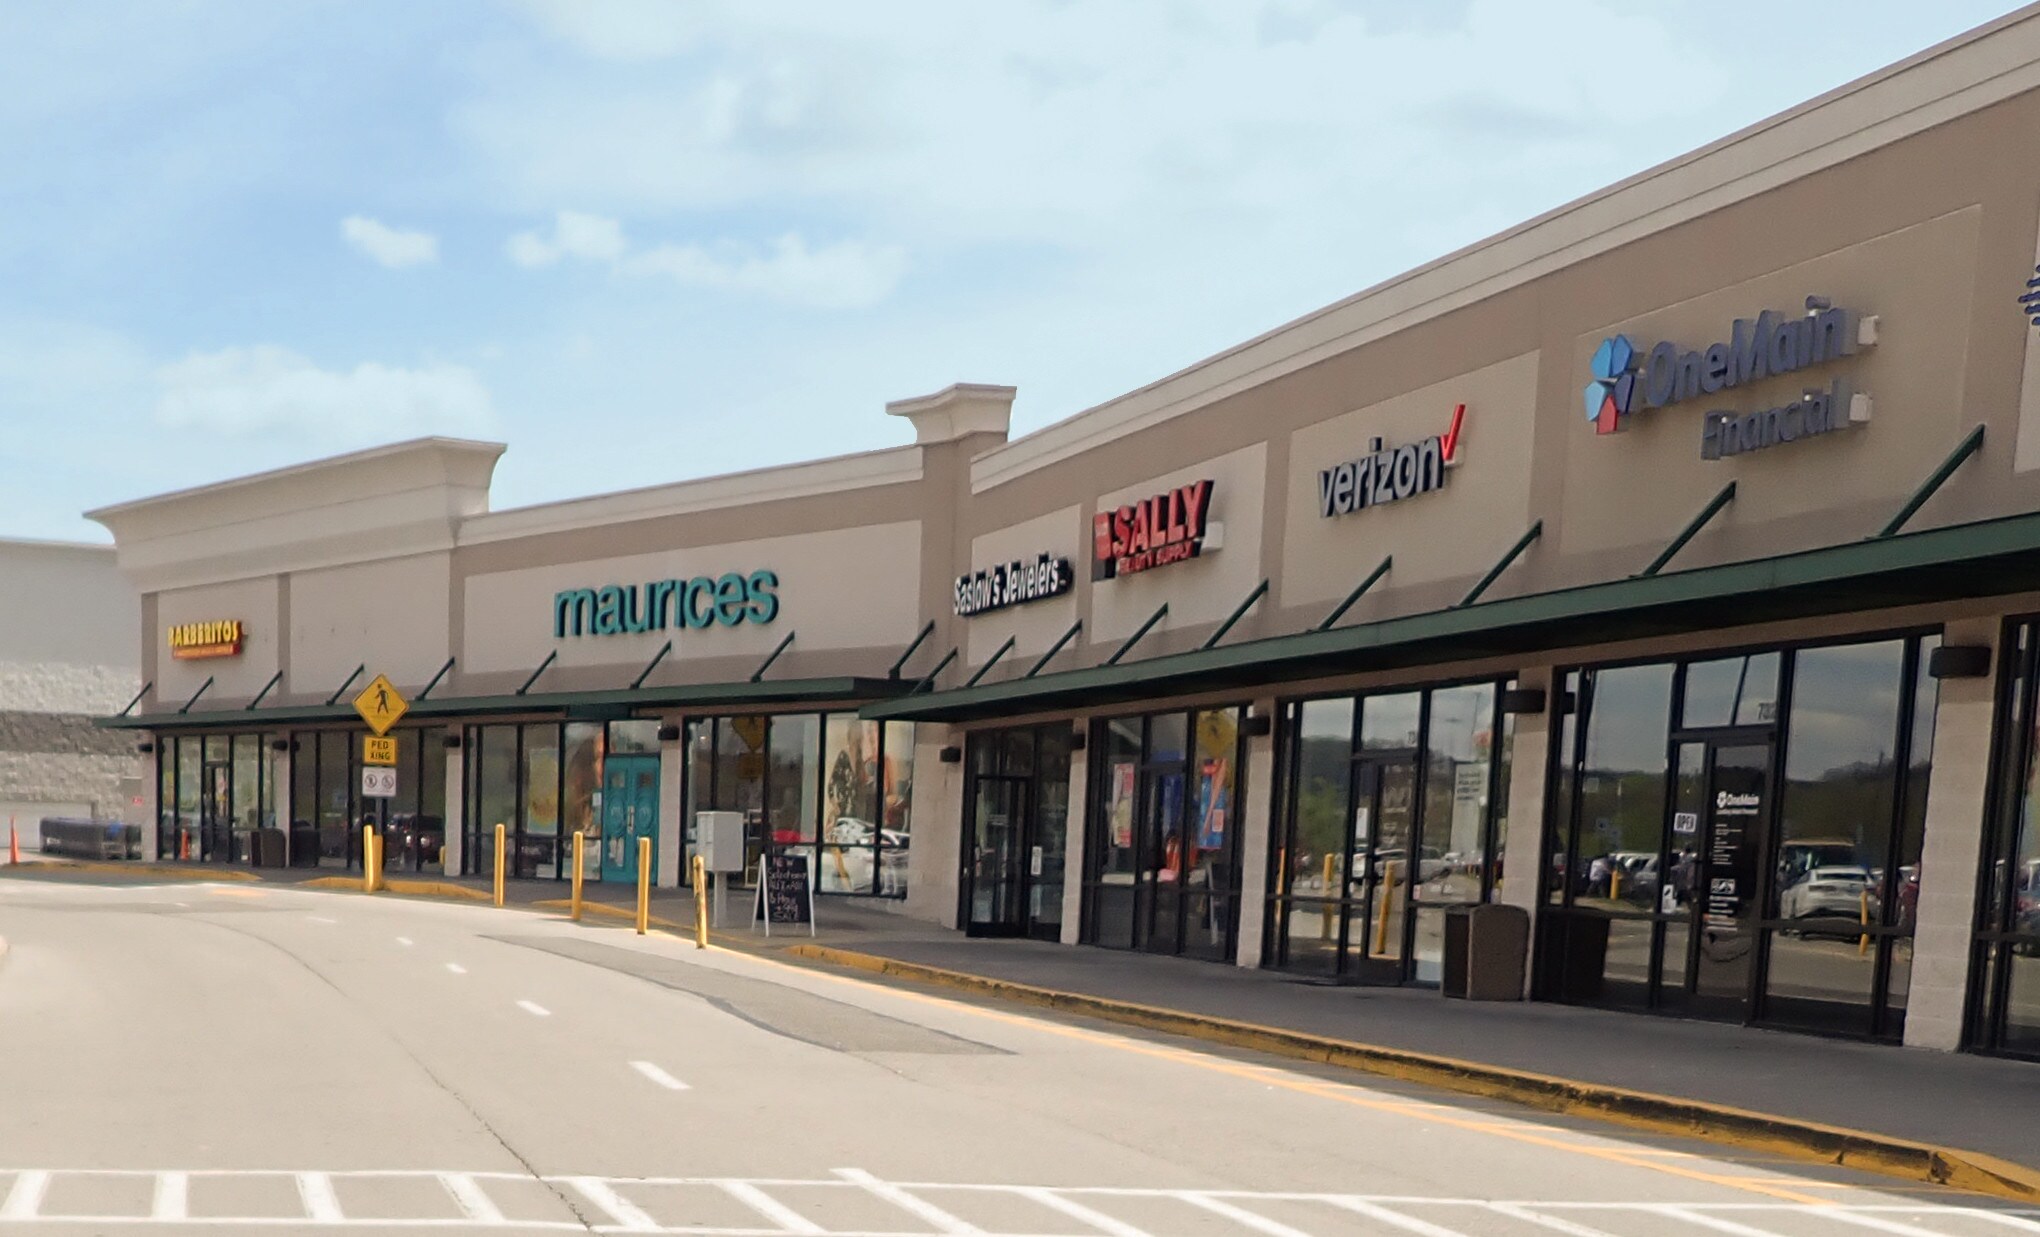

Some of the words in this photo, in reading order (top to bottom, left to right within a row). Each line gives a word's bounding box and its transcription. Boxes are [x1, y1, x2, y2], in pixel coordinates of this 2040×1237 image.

[1646, 295, 1849, 407] OneMain
[1701, 378, 1847, 460] Financial
[1317, 437, 1446, 517] verizon
[1112, 479, 1211, 558] SALLY
[554, 568, 780, 638] maurices
[953, 564, 1001, 616] Saslow's
[1002, 552, 1060, 605] Jewelers
[167, 619, 239, 648] BARBERITOS
[371, 740, 389, 750] PED
